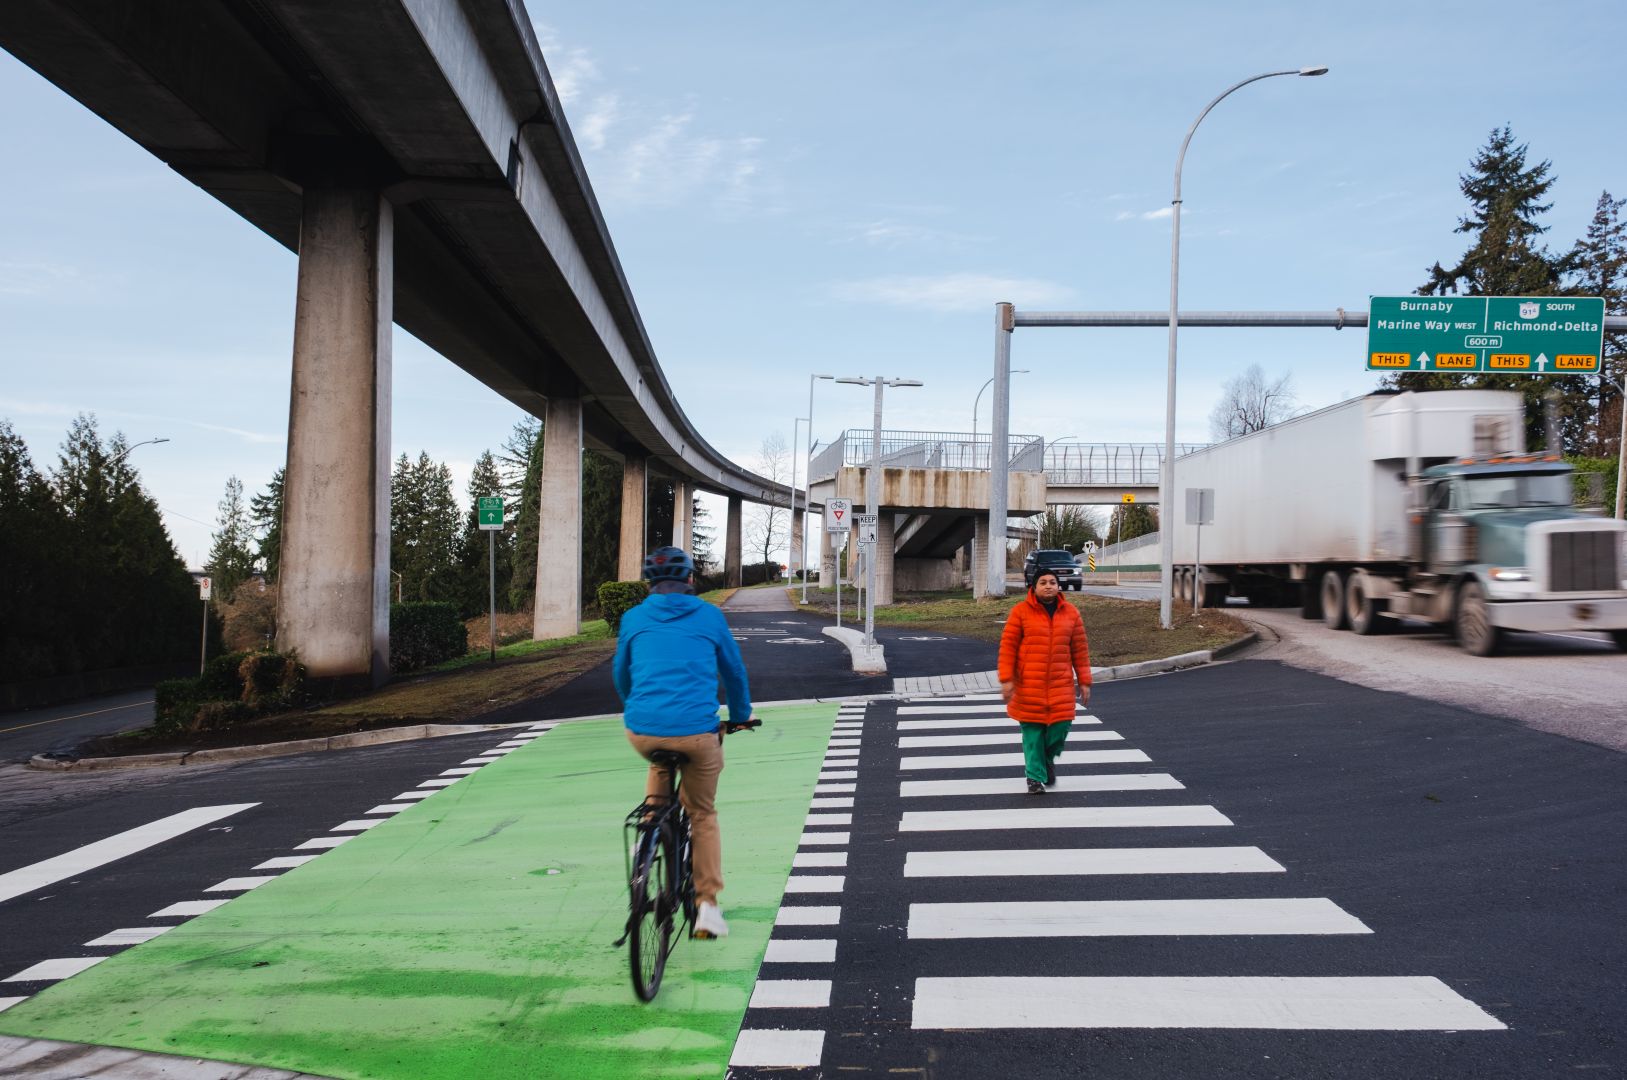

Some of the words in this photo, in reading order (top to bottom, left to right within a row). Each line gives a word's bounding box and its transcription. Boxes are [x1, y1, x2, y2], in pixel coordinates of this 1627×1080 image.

[1400, 301, 1453, 313] Burnaby
[1546, 303, 1575, 311] SOUTH
[1377, 320, 1420, 330] Marine
[1425, 320, 1451, 332] Way
[1454, 322, 1477, 330] WEST
[1469, 338, 1487, 346] 600
[1378, 355, 1405, 364] THIS
[1440, 356, 1472, 365] LANE
[1497, 357, 1525, 366] THIS
[1560, 357, 1592, 367] LANE
